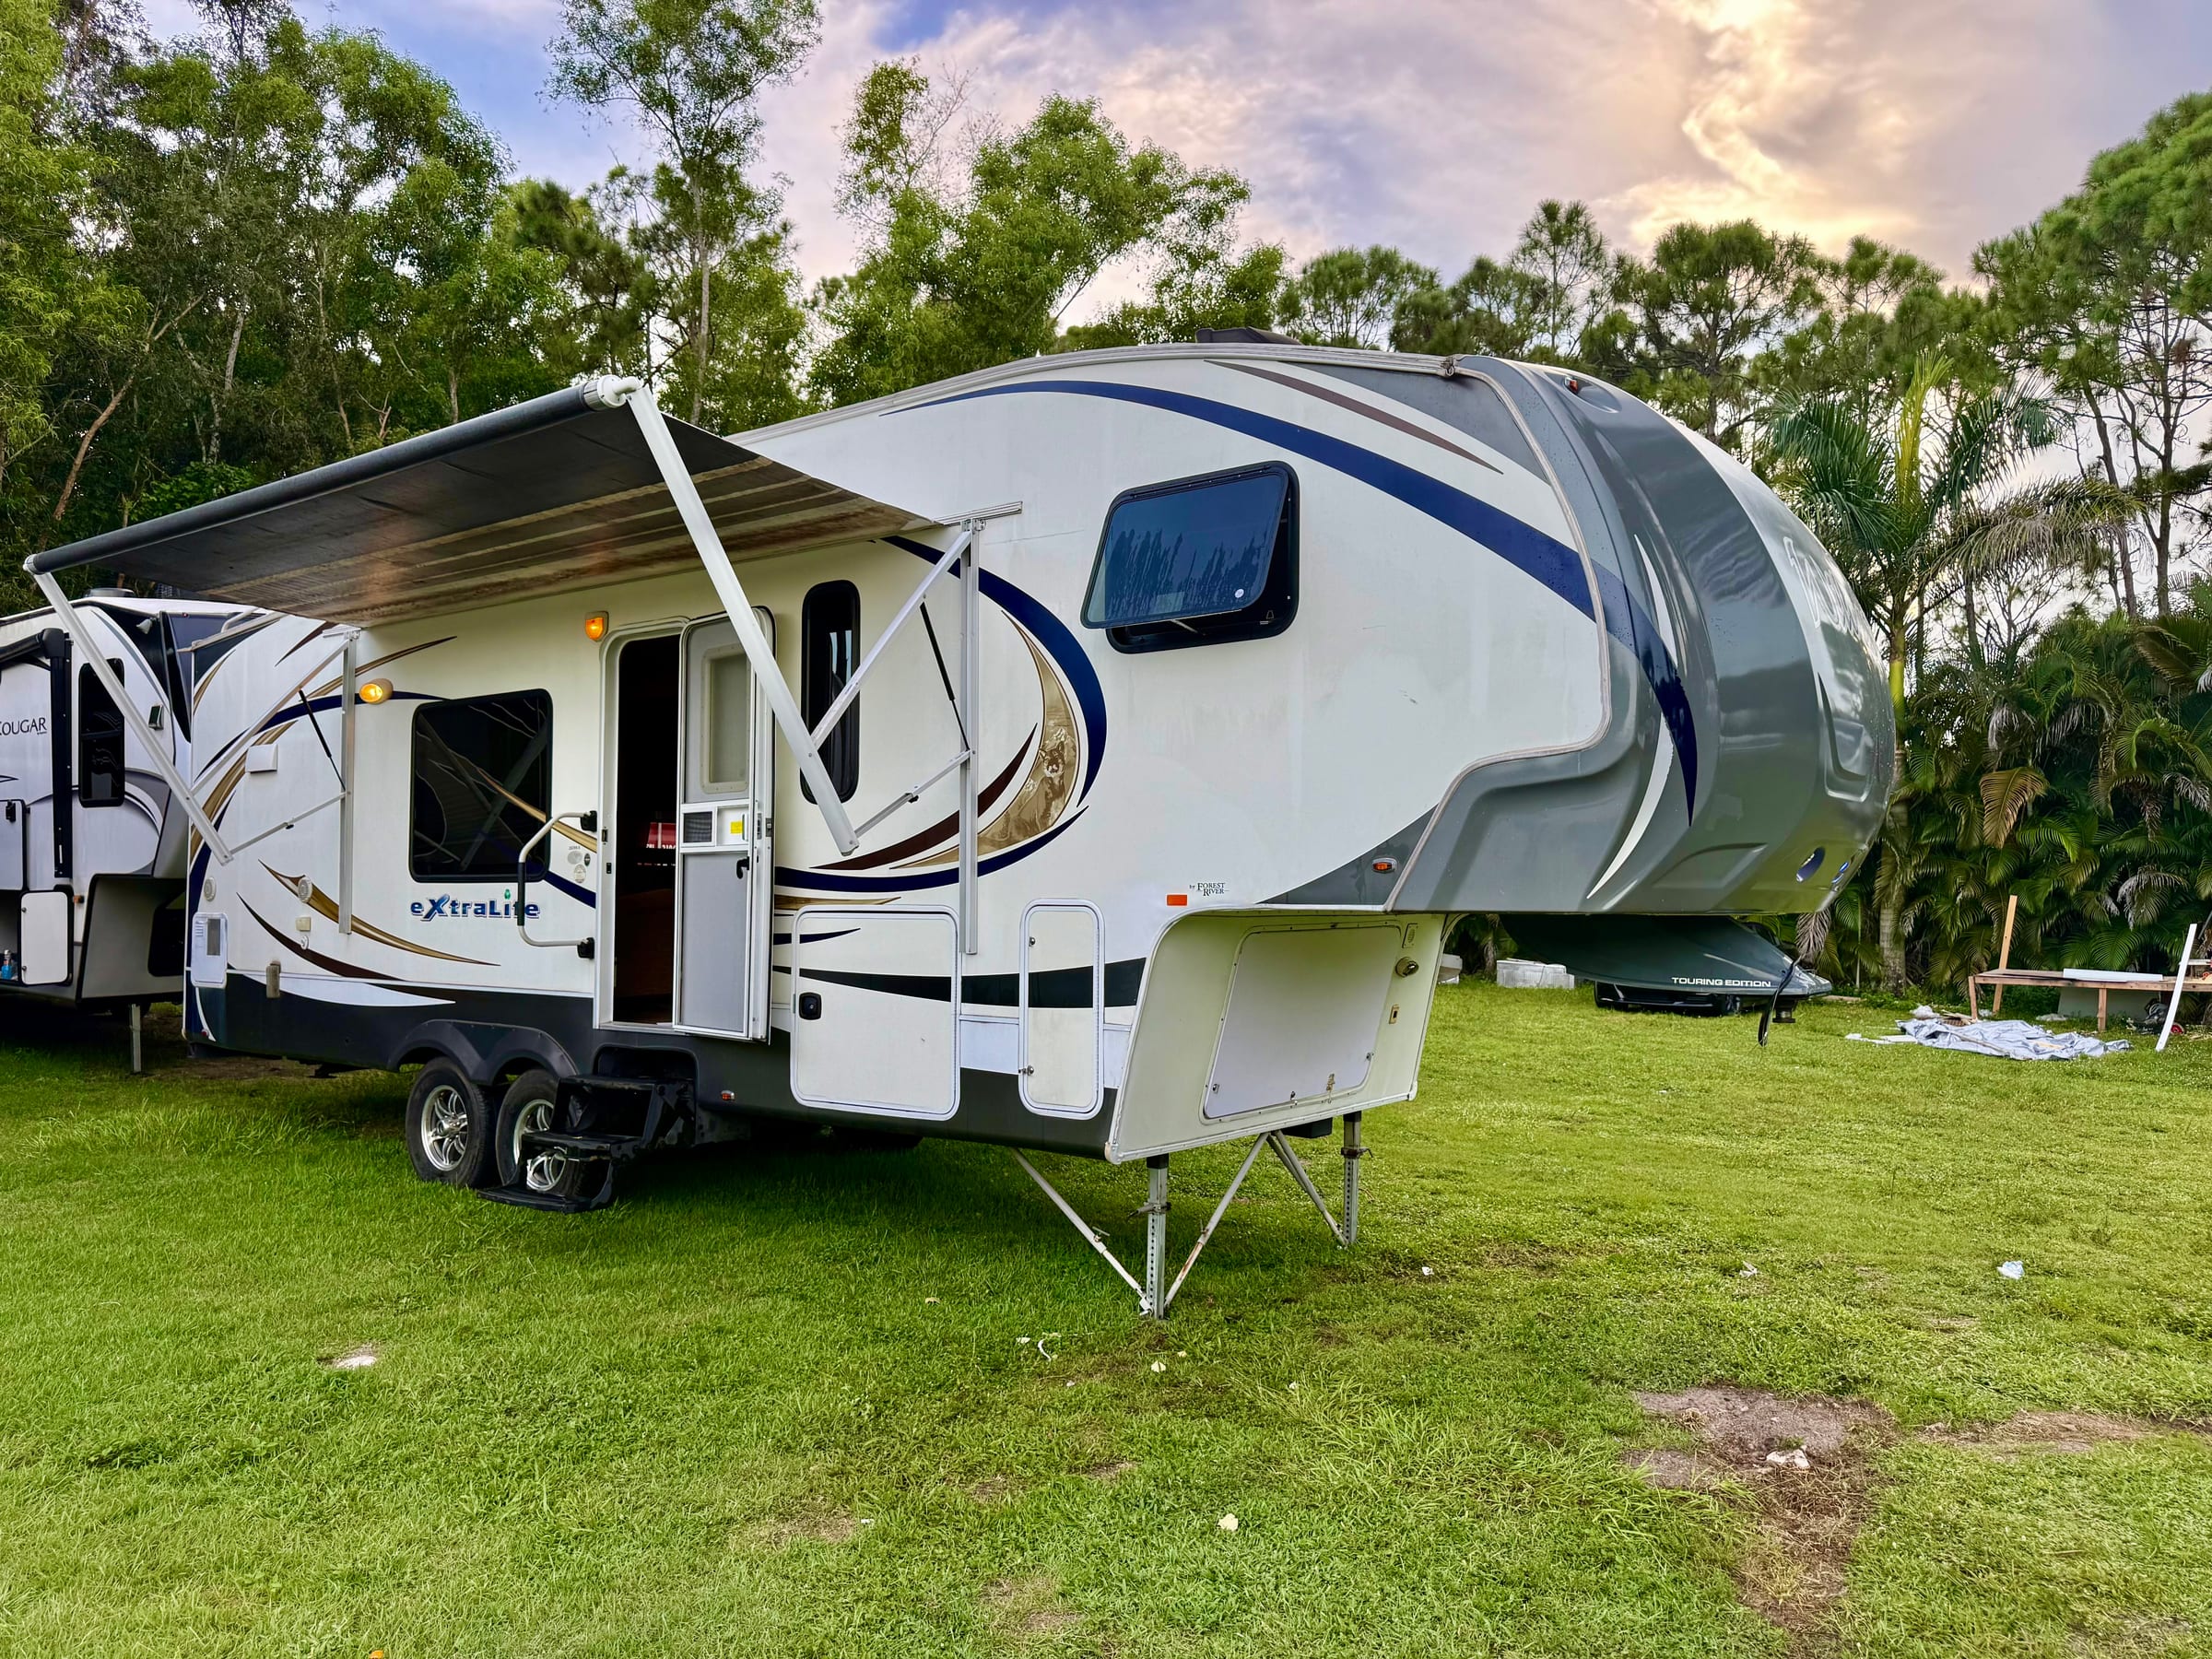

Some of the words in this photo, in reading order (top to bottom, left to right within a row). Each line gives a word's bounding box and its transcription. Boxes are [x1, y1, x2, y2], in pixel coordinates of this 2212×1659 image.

[0, 717, 47, 736] OUGAR
[1203, 888, 1225, 897] RIVER
[1672, 977, 1724, 986] TOURING
[1724, 979, 1771, 987] EDITION
